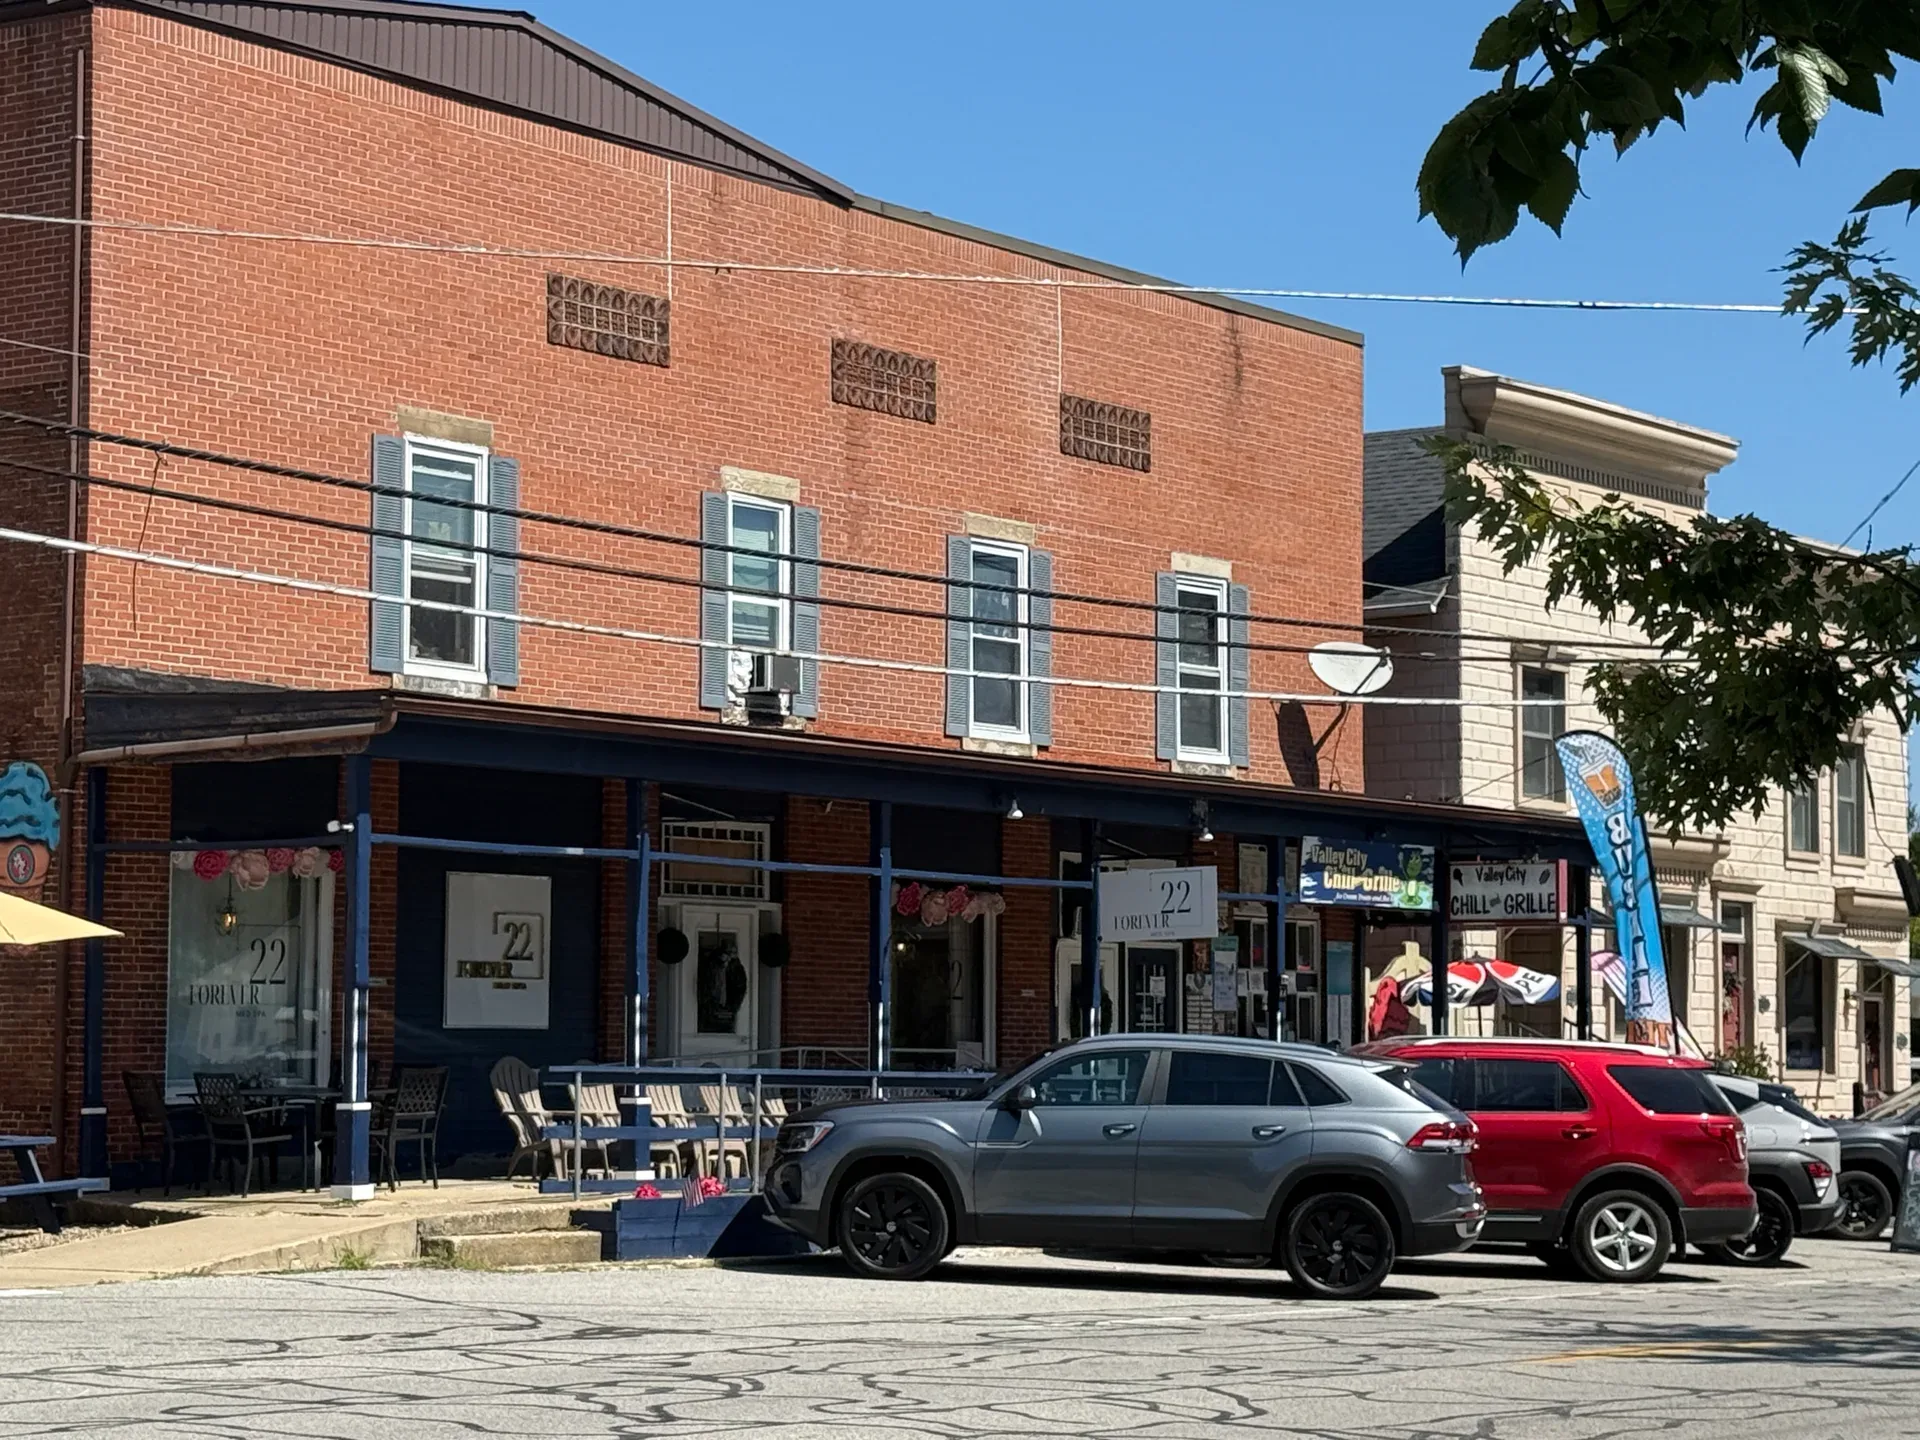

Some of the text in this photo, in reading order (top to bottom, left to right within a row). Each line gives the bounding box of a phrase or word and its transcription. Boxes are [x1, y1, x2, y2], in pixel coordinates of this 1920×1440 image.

[1311, 845, 1368, 872] Valley City
[1475, 866, 1527, 886] Valley City
[1161, 880, 1191, 914] 22
[1451, 894, 1490, 916] CHILL
[1504, 893, 1556, 914] GRILLE
[503, 922, 534, 961] 22
[250, 938, 286, 985] 22
[189, 984, 260, 1006] FOREVER
